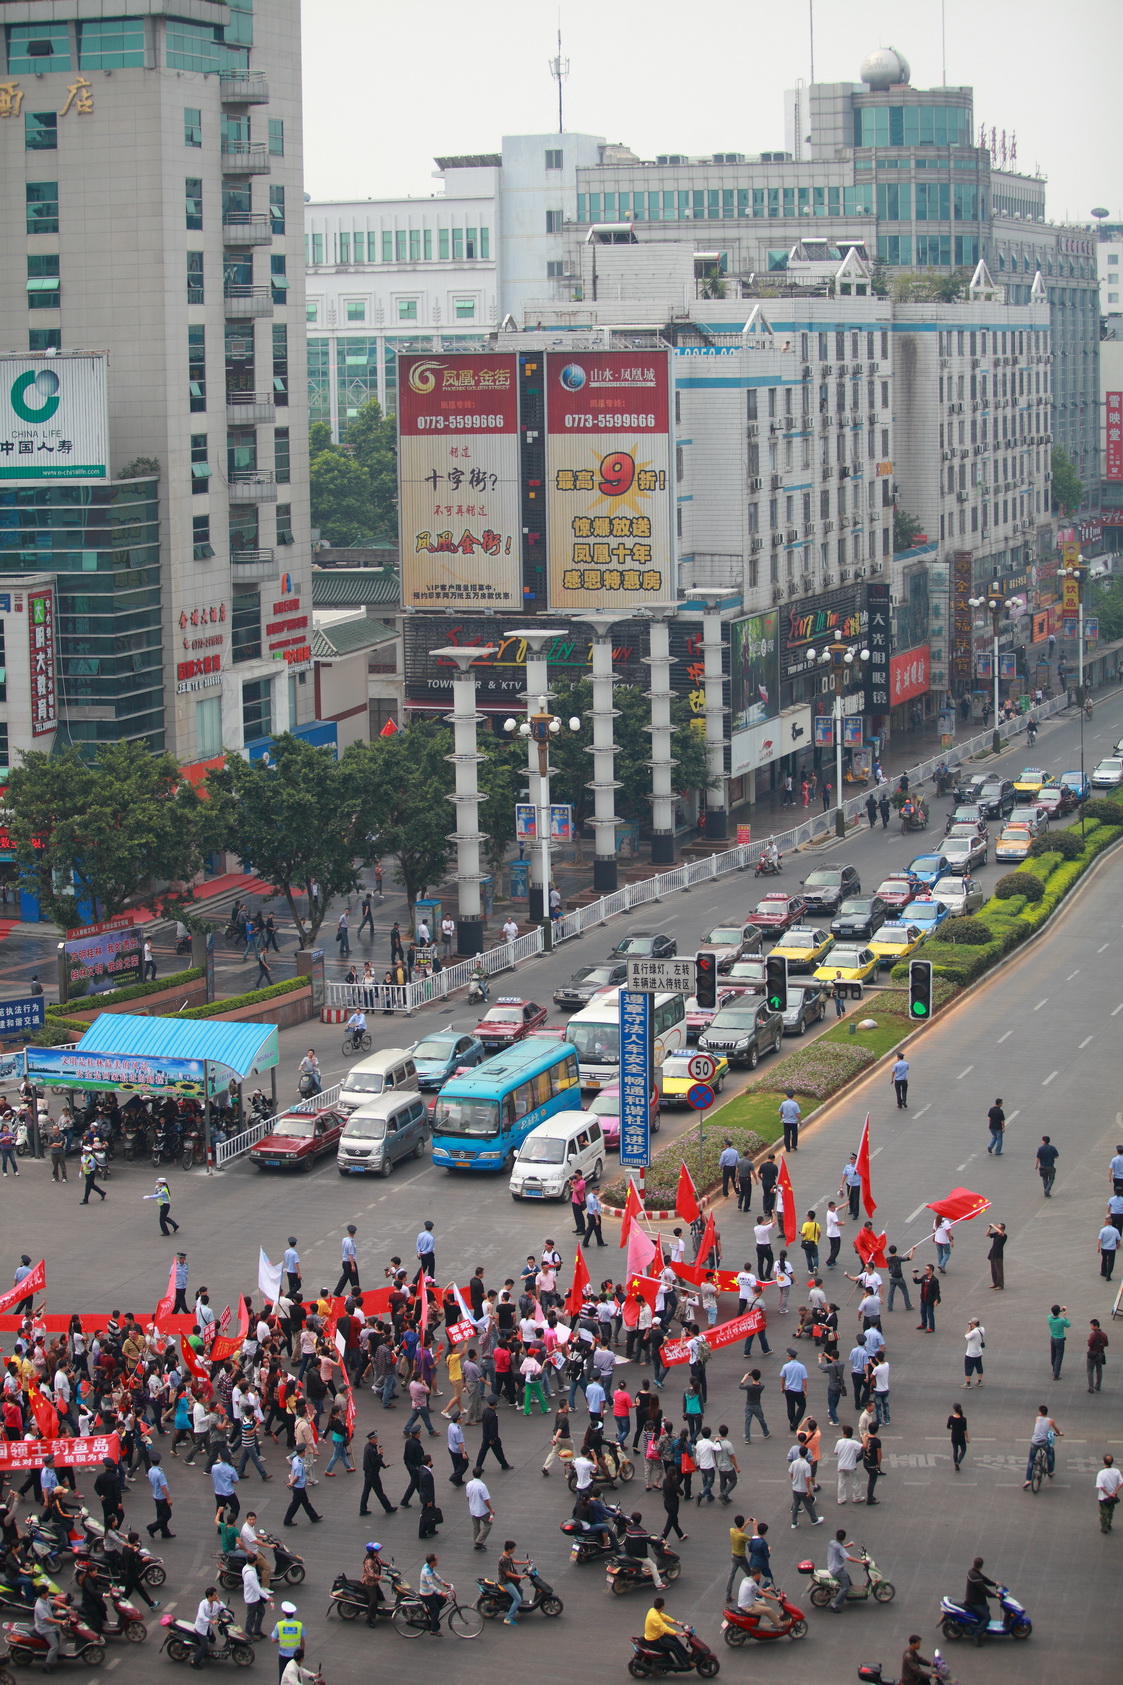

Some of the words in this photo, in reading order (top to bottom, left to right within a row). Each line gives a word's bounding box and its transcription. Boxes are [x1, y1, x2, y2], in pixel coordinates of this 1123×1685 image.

[590, 368, 656, 382] 山水·凤凰城
[417, 415, 504, 430] 0773-5599666
[564, 414, 656, 428] 0773-5599666
[11, 430, 39, 439] CHINA
[42, 429, 62, 438] LIFE
[0, 439, 73, 456] 中国人寿
[42, 468, 100, 476] www.e-chinalife.com
[572, 516, 652, 538] 惊爆放送
[572, 543, 653, 564] 凤凰十年
[562, 569, 662, 591] 感恩特惠房
[871, 612, 888, 704] 大光明眼镜
[501, 680, 522, 690] KTV
[70, 946, 103, 963] 文明桂林
[107, 937, 139, 955] 我的责任
[70, 963, 103, 981] 桂林文明
[107, 955, 139, 973] 我的光荣
[632, 963, 690, 976] 直行绿灯，左转
[632, 976, 694, 991] 车辆进入待转区。
[695, 1060, 709, 1076] 50
